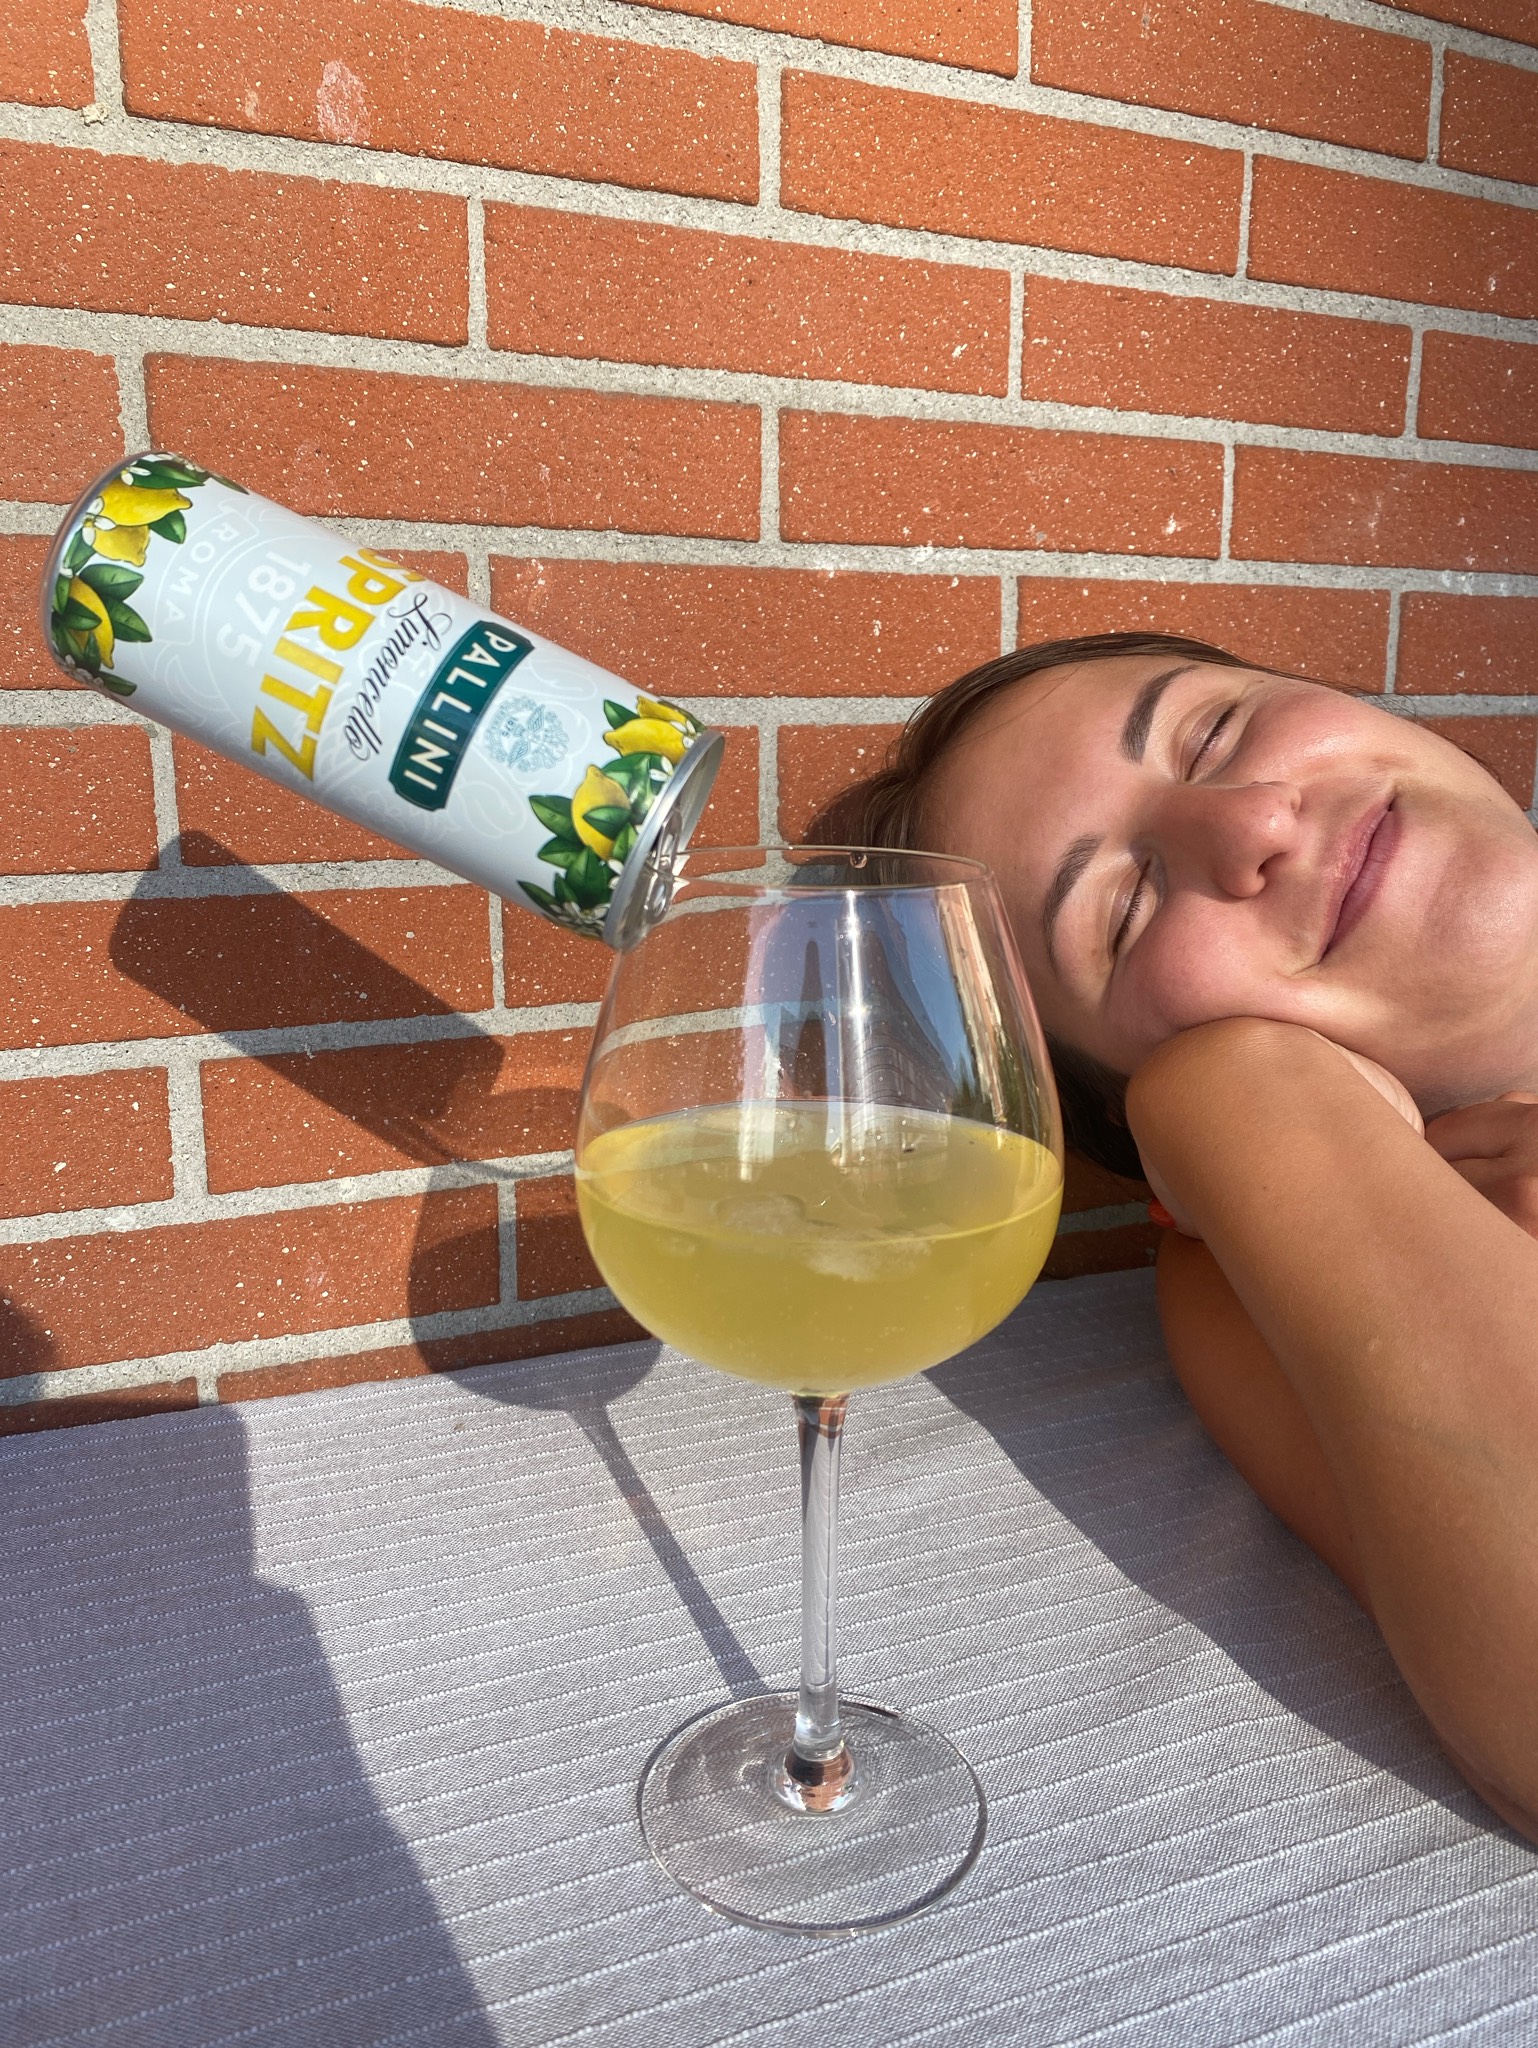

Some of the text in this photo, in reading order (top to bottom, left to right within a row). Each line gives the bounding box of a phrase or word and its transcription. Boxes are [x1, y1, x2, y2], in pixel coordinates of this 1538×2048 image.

[164, 522, 240, 626] ROMA
[216, 551, 314, 667] 1875
[344, 592, 453, 761] Limoncello
[404, 630, 518, 791] PALLINI
